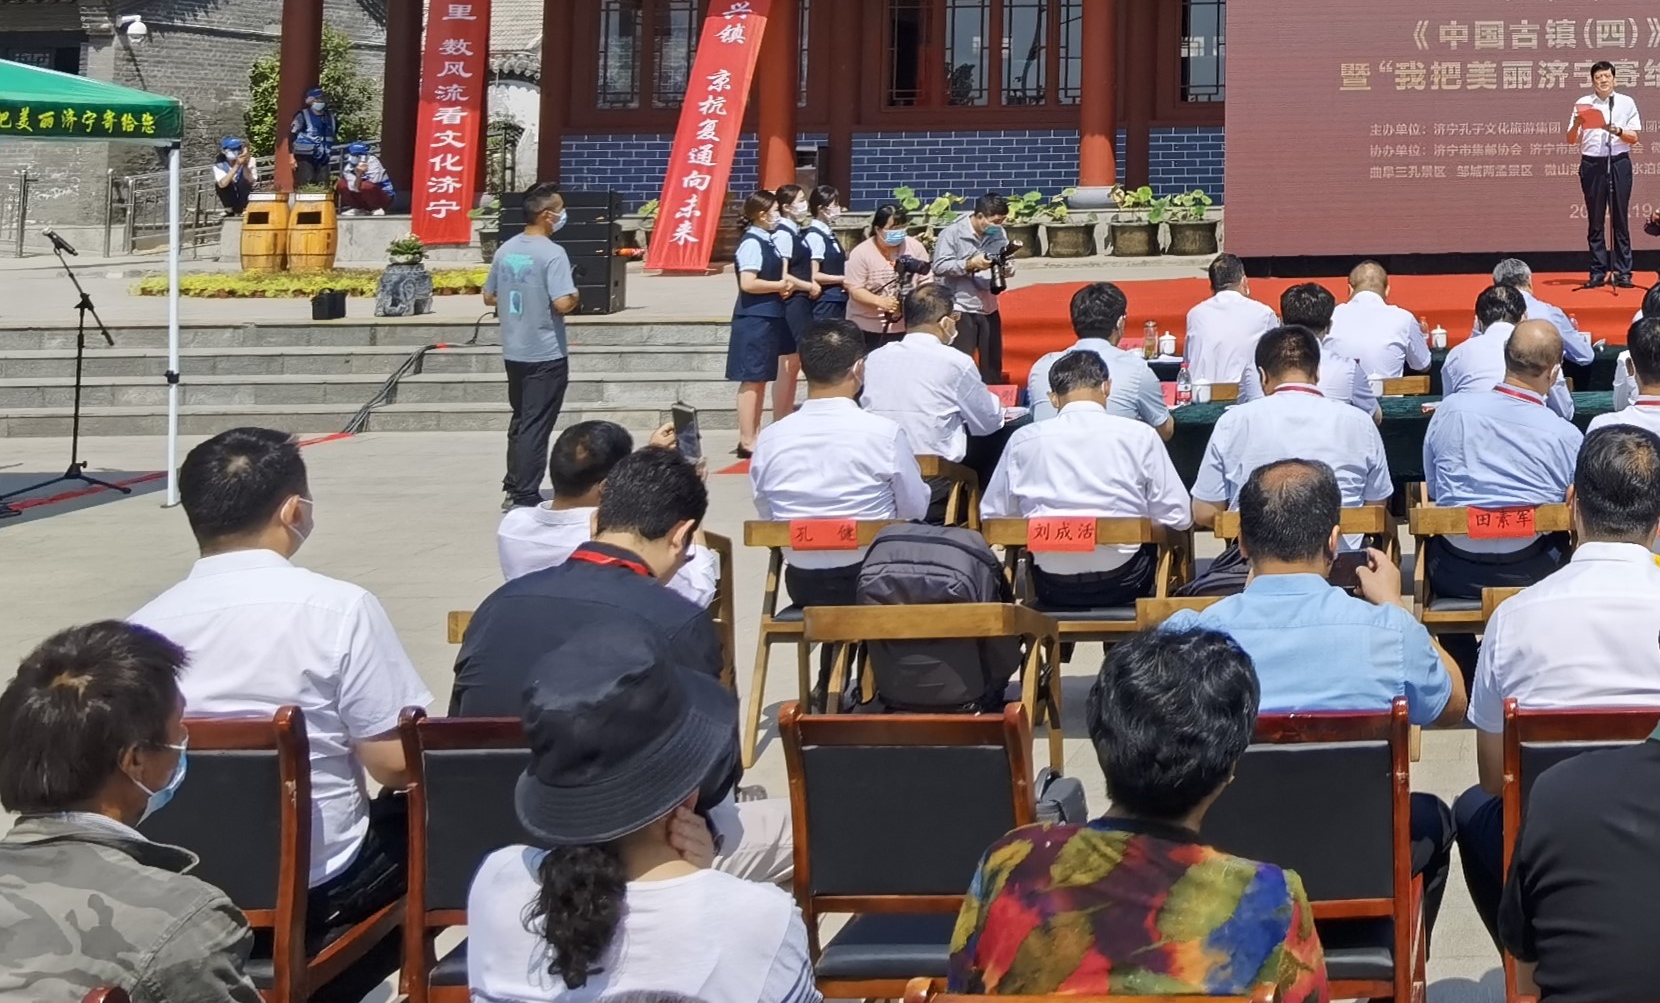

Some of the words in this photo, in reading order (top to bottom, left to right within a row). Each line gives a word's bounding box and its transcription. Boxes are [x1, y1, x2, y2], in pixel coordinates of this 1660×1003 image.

[425, 38, 475, 219] 数风流看文化济宁
